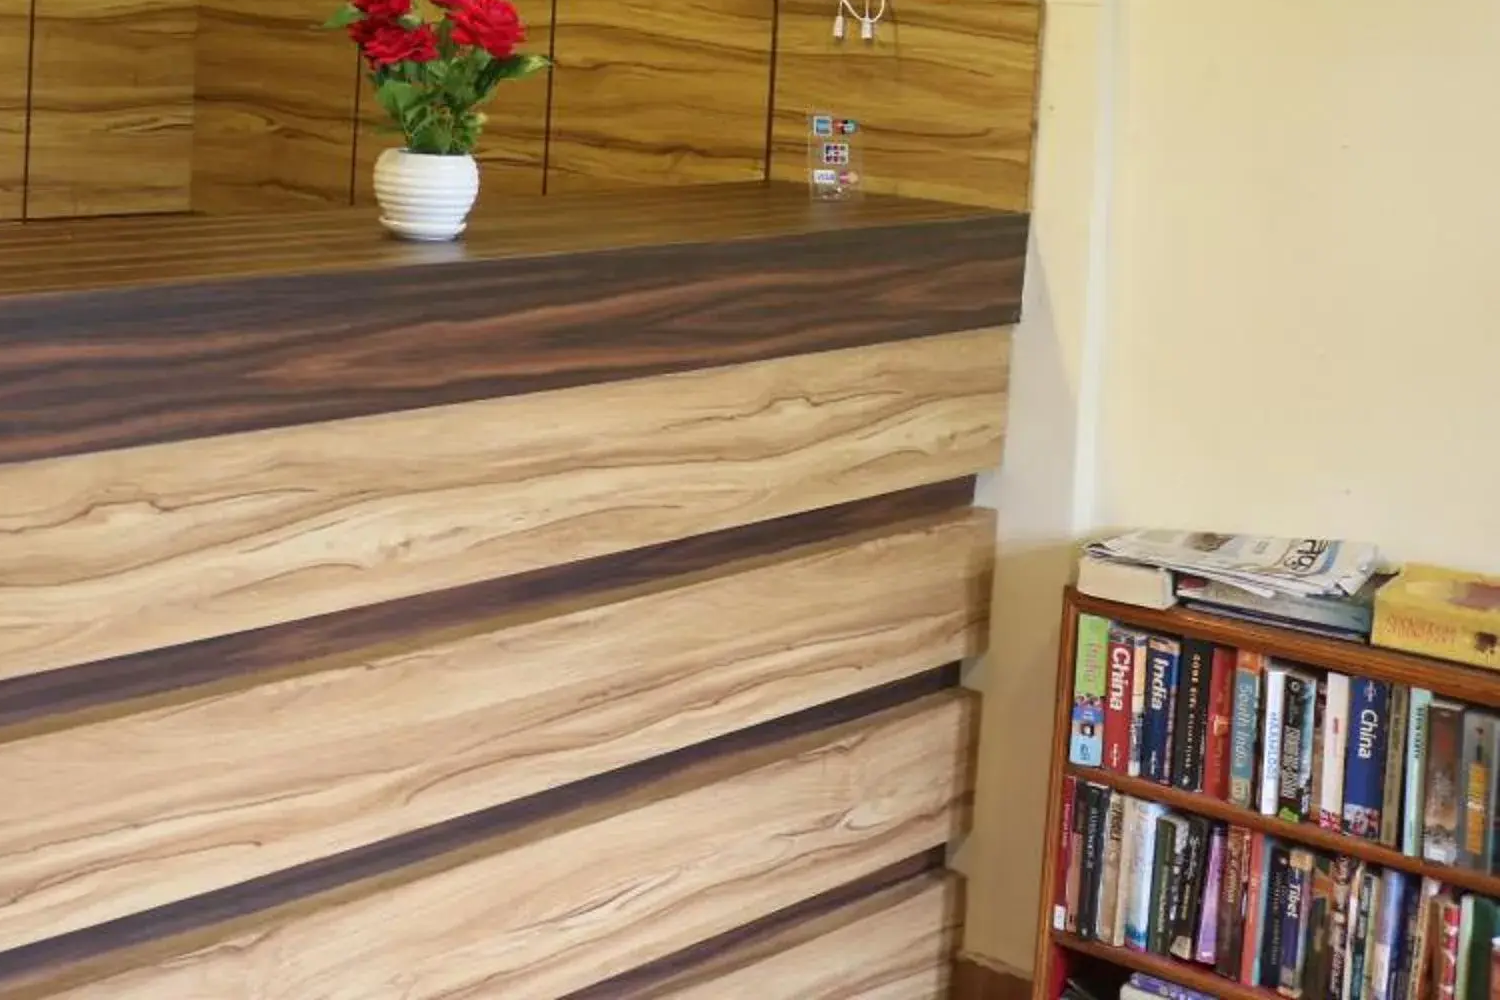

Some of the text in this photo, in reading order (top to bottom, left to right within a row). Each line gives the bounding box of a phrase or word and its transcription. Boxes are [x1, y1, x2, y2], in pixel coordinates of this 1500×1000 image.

[1109, 647, 1131, 711] China
[1151, 657, 1170, 711] India
[1357, 709, 1379, 760] China
[1286, 883, 1301, 919] Tibet
